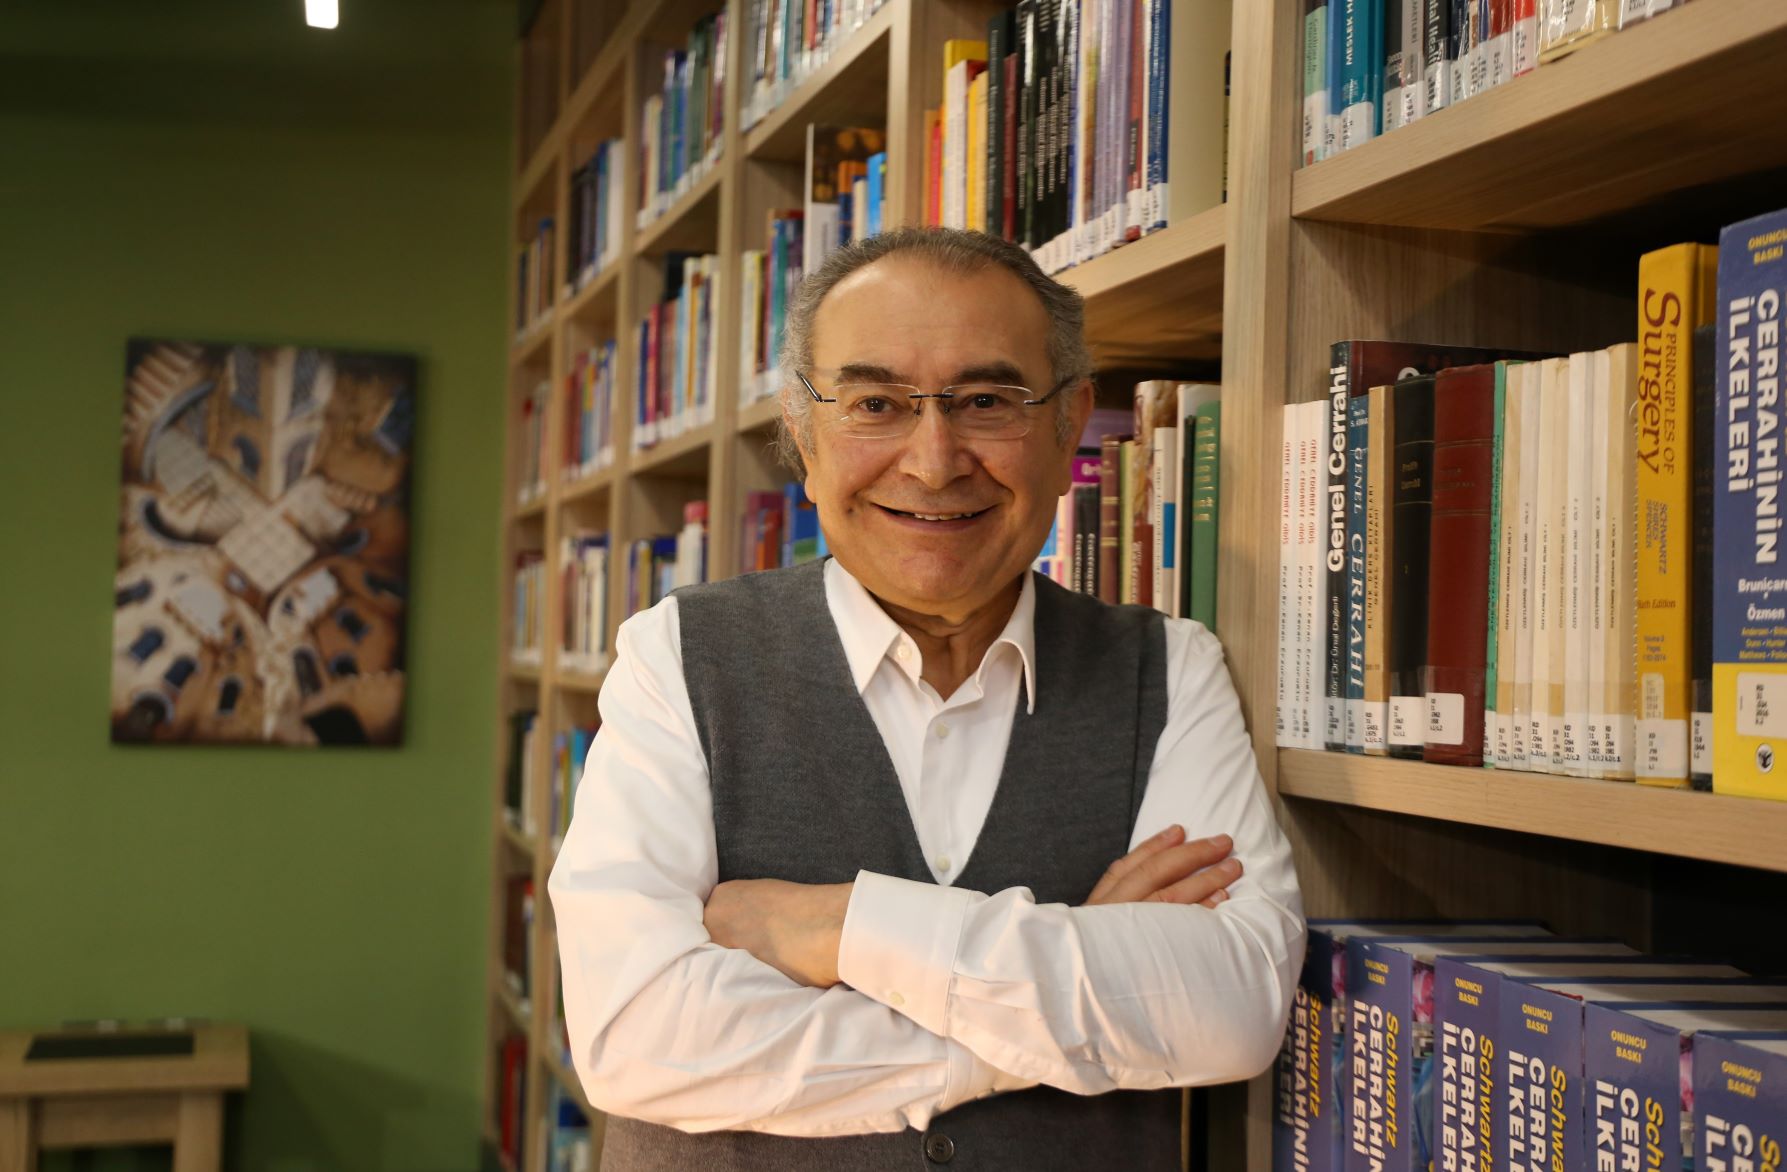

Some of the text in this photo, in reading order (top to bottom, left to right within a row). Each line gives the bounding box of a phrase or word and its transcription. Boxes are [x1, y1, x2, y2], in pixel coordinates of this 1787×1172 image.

[1754, 246, 1784, 266] BASKI
[1638, 287, 1682, 475] Surgery
[1663, 333, 1676, 476] PRINCIPLES OF
[1728, 296, 1755, 492] İLKELERİ
[1757, 288, 1783, 564] CERRAHİNİN
[1326, 366, 1348, 574] Genel Cerrahi
[1351, 447, 1364, 688] GENEL CERRAHİ
[1746, 603, 1785, 622] Özmen
[1455, 977, 1483, 994] ONUNCU
[1458, 991, 1479, 1006] BASKI
[1522, 1003, 1552, 1021] ONUNCU
[1309, 992, 1322, 1118] Schwartz
[1526, 1018, 1548, 1034] BASKI
[1610, 1030, 1647, 1050] ONUNCU
[1616, 1046, 1642, 1064] BASKI
[1294, 985, 1310, 1172] CERRAHİNİ
[1353, 1000, 1369, 1156] İLKELERİ
[1386, 1011, 1399, 1147] Schwartz
[1721, 1061, 1762, 1082] ONUNCU
[1727, 1078, 1756, 1098] BASKI
[1645, 1097, 1664, 1172] Sch
